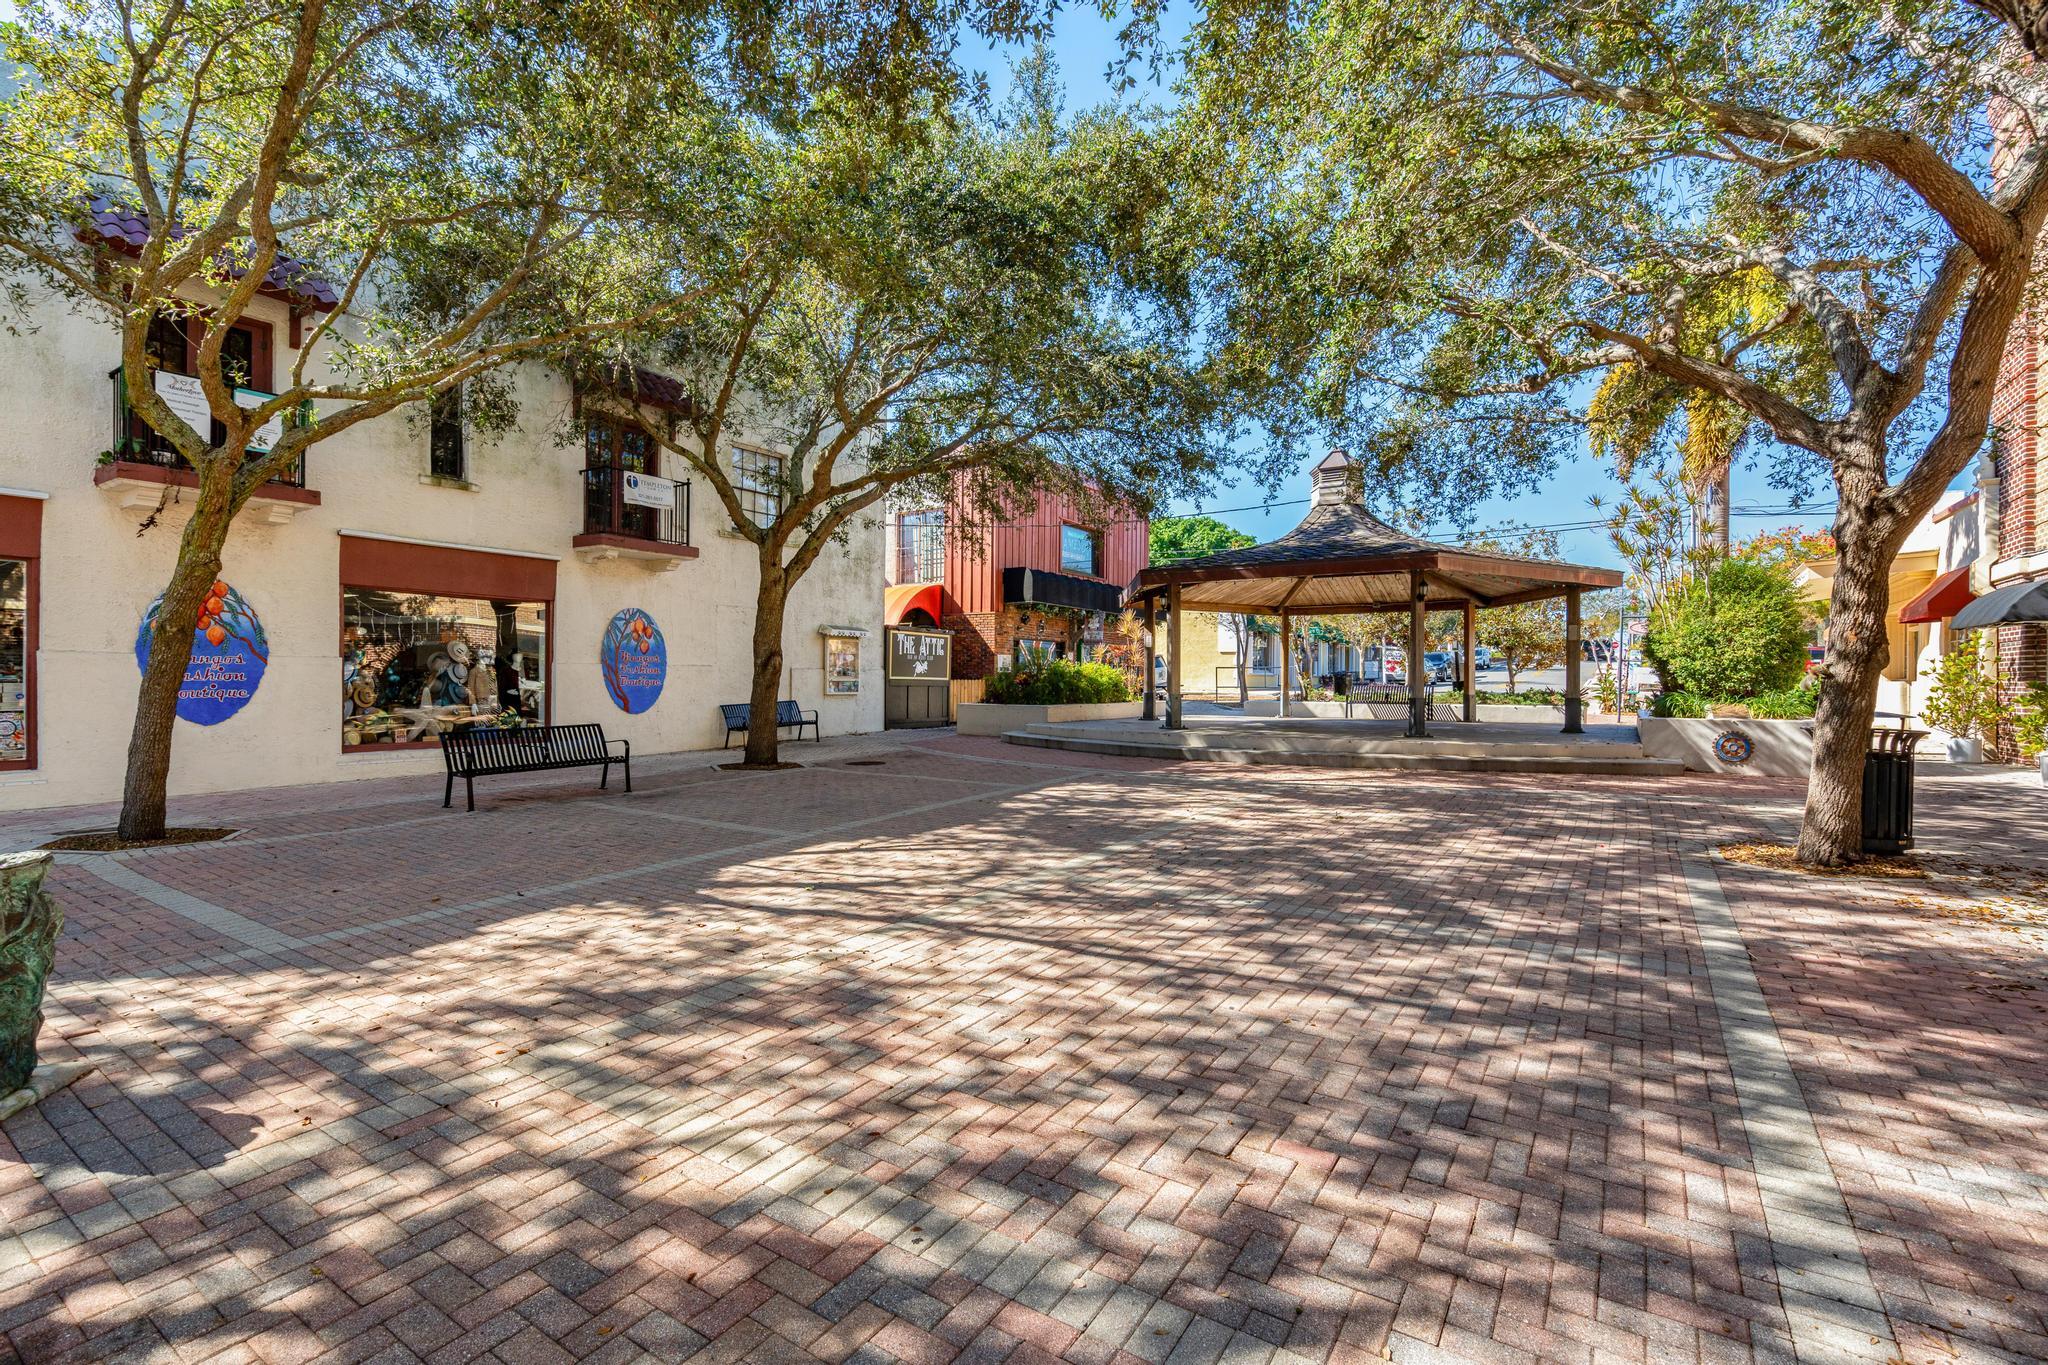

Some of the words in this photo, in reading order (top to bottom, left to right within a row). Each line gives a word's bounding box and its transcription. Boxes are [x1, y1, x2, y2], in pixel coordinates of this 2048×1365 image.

[641, 480, 671, 490] TEMPLETON
[897, 633, 915, 655] THE
[920, 635, 945, 656] ATTIC
[620, 651, 660, 666] Mangos
[620, 664, 660, 675] Fashion
[620, 675, 661, 688] Boutique
[178, 683, 250, 702] outique
